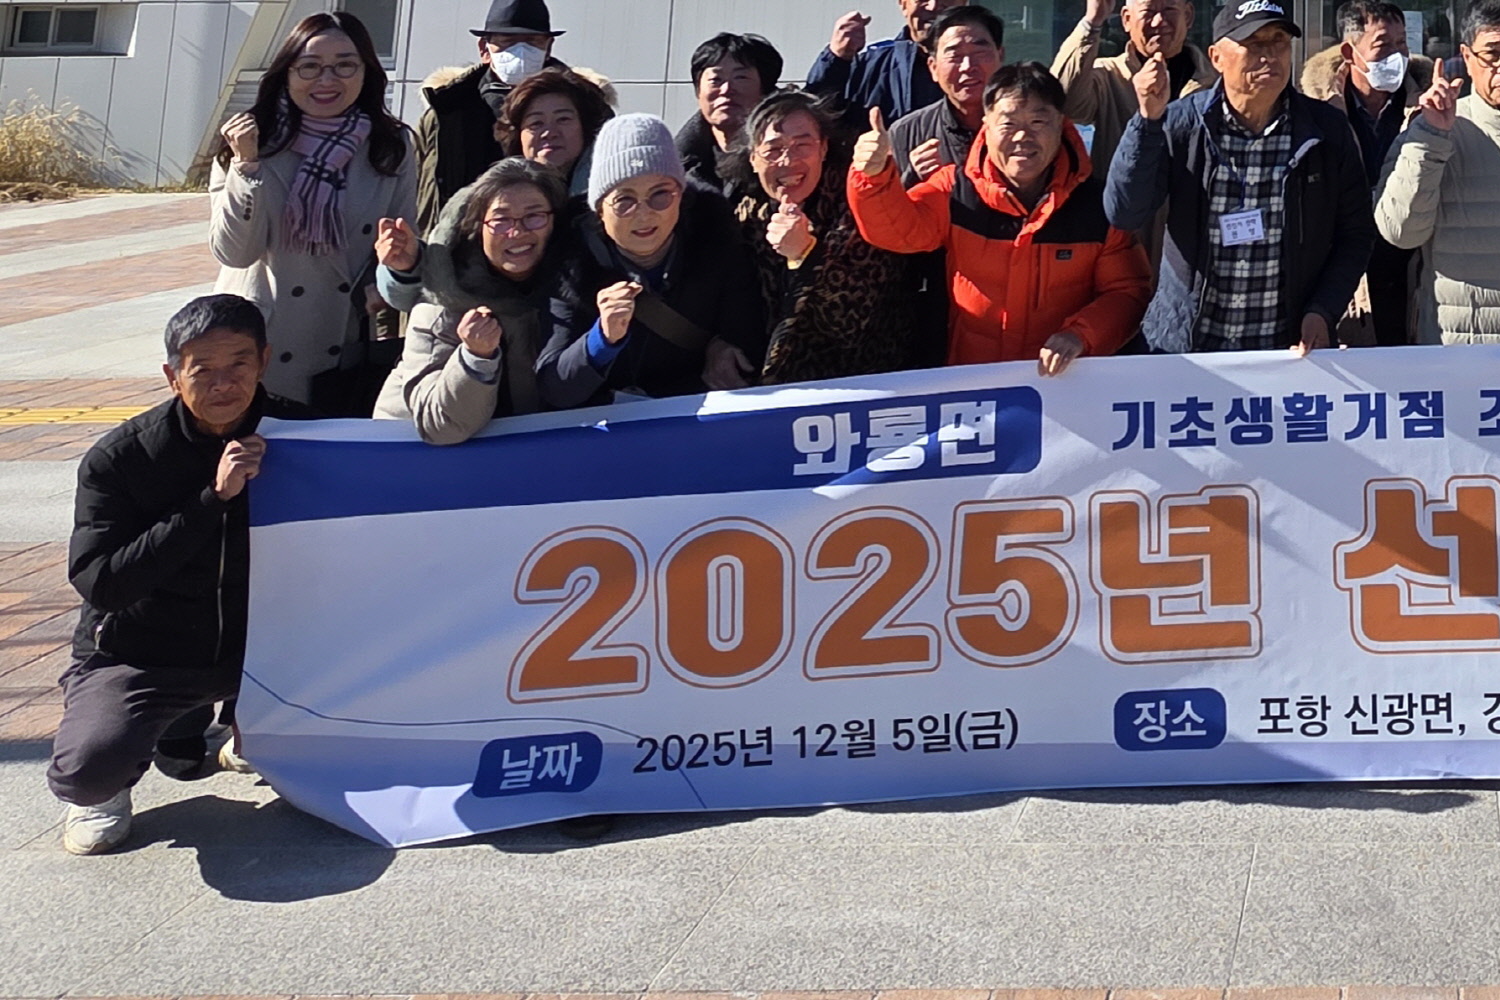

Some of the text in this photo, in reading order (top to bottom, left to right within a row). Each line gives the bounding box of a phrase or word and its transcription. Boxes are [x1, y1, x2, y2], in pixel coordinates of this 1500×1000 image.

[792, 400, 997, 476] 와룡면
[1112, 391, 1446, 451] 기초생활거점
[507, 484, 1263, 704] 2025년
[633, 708, 1020, 774] 2025년 12월 5일(금)
[1132, 699, 1208, 743] 장소
[1256, 693, 1332, 737] 포항
[1343, 691, 1467, 736] 신광면,
[499, 742, 584, 790] 날짜
